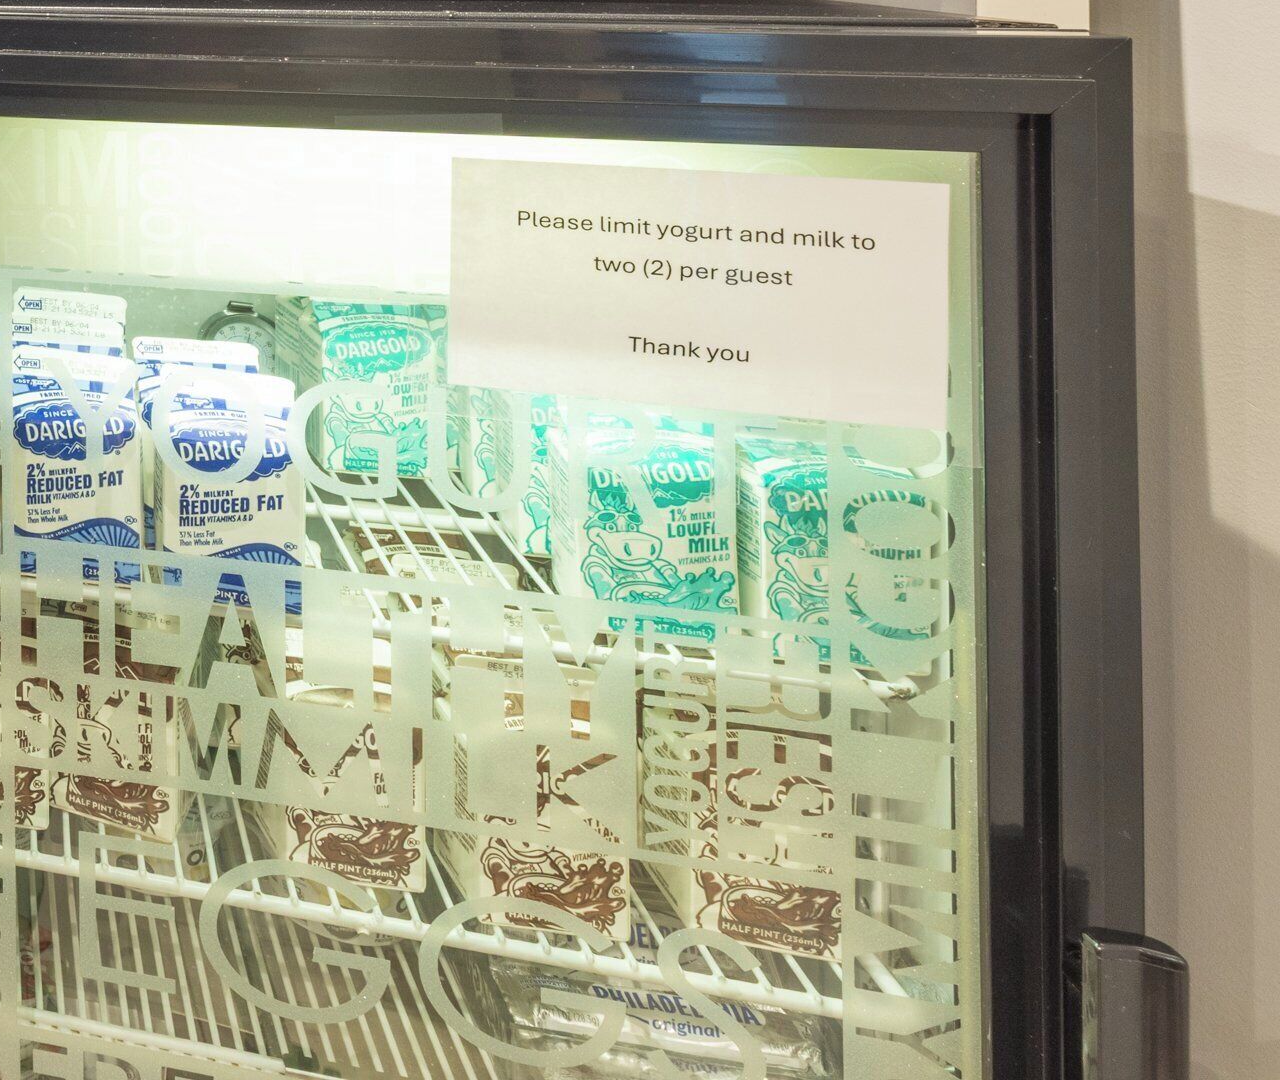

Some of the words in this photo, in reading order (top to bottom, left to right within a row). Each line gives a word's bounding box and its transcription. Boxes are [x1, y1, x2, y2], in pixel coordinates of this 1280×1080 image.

[517, 209, 594, 233] Please
[599, 214, 651, 236] limit
[656, 220, 733, 244] yogurt
[739, 226, 785, 246] and
[792, 229, 846, 250] milk
[851, 234, 876, 252] to
[593, 256, 637, 276] two
[642, 259, 673, 281] (2)
[679, 262, 719, 283] per
[724, 266, 793, 287] guest
[25, 300, 40, 308] OPEN
[349, 331, 376, 339] SINCE
[144, 345, 161, 353] OPEN
[335, 334, 422, 360] DARIGOLD
[628, 335, 701, 360] Thank
[706, 344, 751, 364] you
[21, 359, 38, 367] OPEN
[43, 409, 74, 418] SINCE
[25, 417, 125, 443] DARIGLD
[198, 430, 231, 438] SINCE
[179, 437, 286, 463] DARIGLD
[26, 463, 46, 478] 2%
[48, 467, 77, 476] MILKFAT
[345, 458, 366, 468] HALF
[594, 460, 714, 488] DAIGOLD
[26, 474, 93, 494] REDUCED
[98, 470, 125, 488] FAT
[26, 494, 52, 505] MILK
[52, 491, 80, 501] VITAMINS
[179, 484, 200, 499] 2%
[203, 489, 234, 498] MILKFAT
[40, 507, 51, 515] Less
[52, 507, 61, 515] Fat
[179, 497, 251, 515] REDUCED
[257, 494, 285, 512] FAT
[27, 516, 40, 524] Than
[40, 515, 57, 523] Whole
[58, 514, 69, 522] Milk
[179, 516, 206, 527] MILK
[206, 515, 236, 524] VITAMINS
[669, 508, 687, 522] 1%
[206, 530, 216, 538] Fat
[179, 539, 192, 547] Than
[211, 538, 224, 546] Milk
[688, 536, 730, 555] MILK
[677, 556, 712, 565] VITAMINS
[20, 550, 636, 740] HEALTHY
[487, 661, 509, 671] BEST
[642, 620, 717, 846] YOGURT
[724, 626, 835, 874] FRESH
[14, 676, 242, 787] SKIM
[255, 706, 627, 846] MILK
[69, 795, 92, 808] HALF
[92, 801, 113, 814] PINT
[311, 859, 336, 871] HALF
[338, 864, 362, 874] PINT
[721, 921, 751, 935] HALF
[753, 926, 780, 940] PINT
[782, 932, 824, 949] (236mL)
[652, 1018, 721, 1039] original
